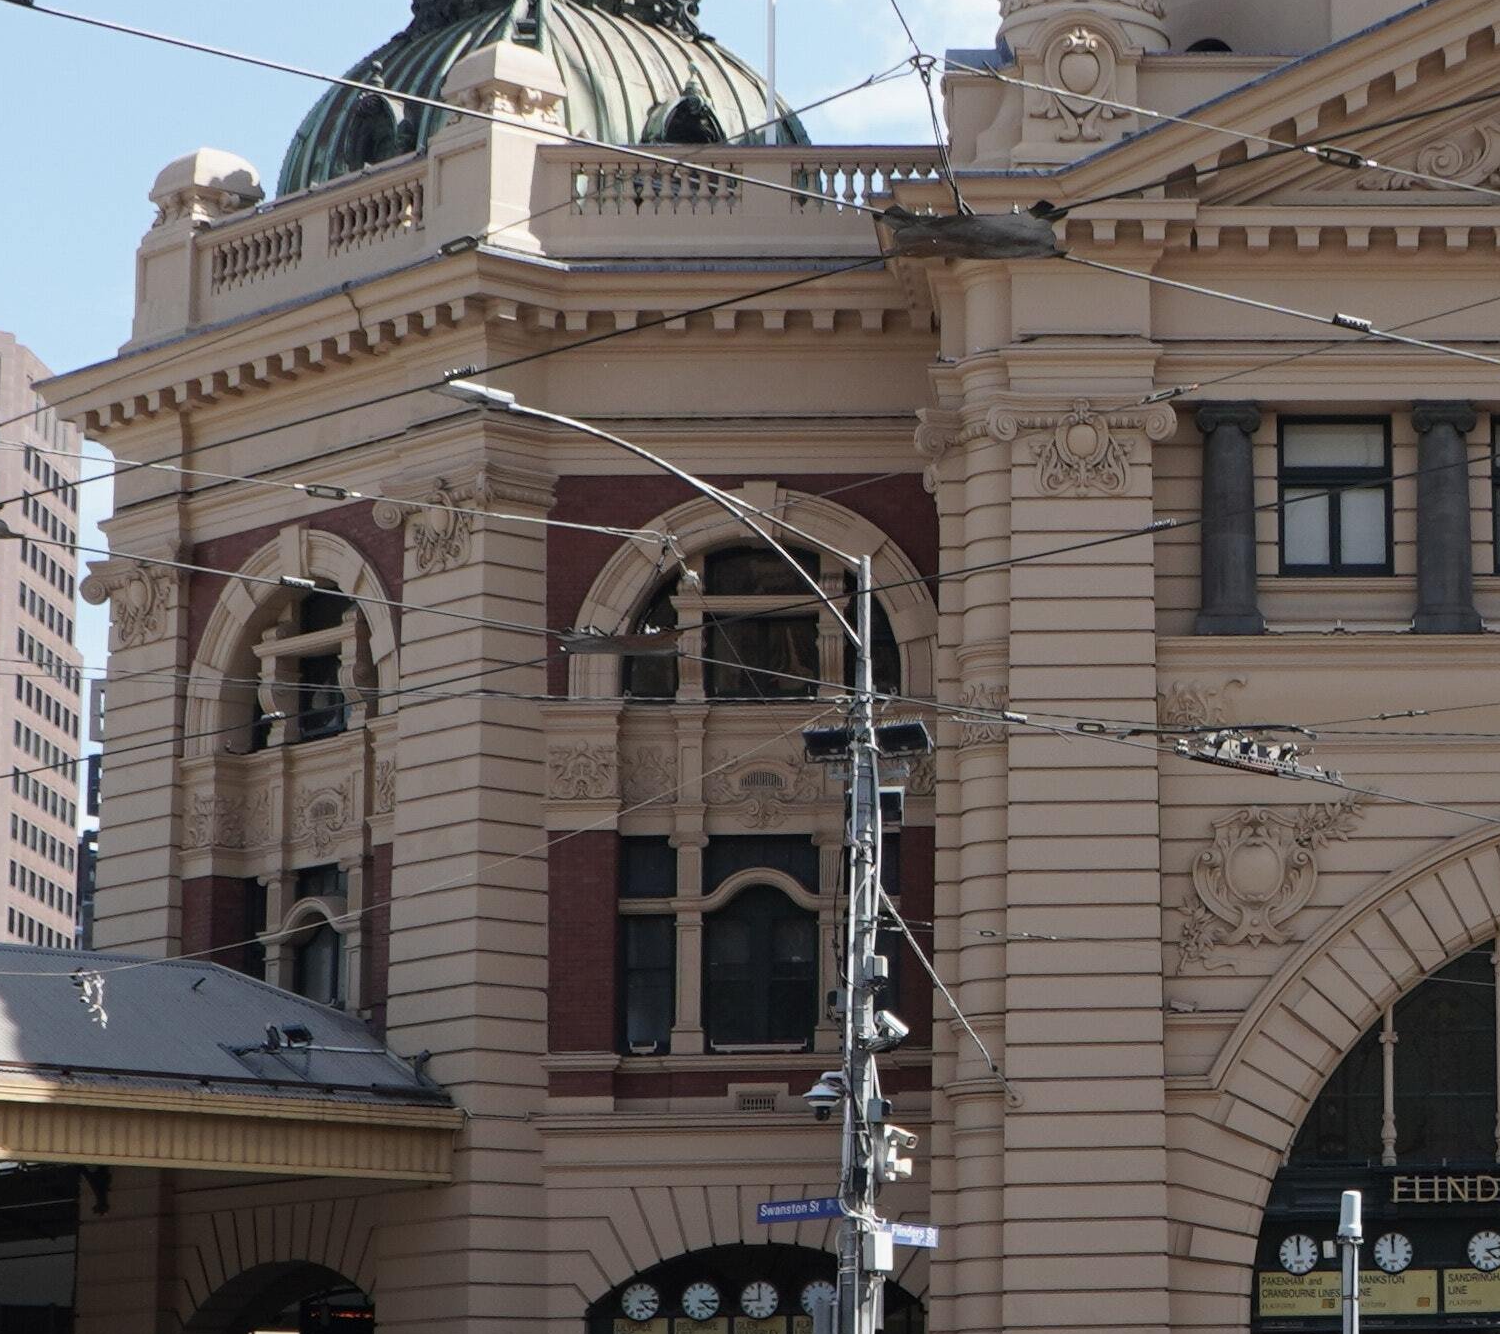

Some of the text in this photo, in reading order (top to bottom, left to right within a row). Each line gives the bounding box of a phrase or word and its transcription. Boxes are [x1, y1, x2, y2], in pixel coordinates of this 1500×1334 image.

[760, 1200, 820, 1217] Swanston St
[1261, 1274, 1322, 1286] PAKENHAM and
[1359, 1274, 1405, 1285] RANKSTON
[1261, 1288, 1340, 1298] CRANBOURNE LINES
[1448, 1285, 1468, 1295] LINE
